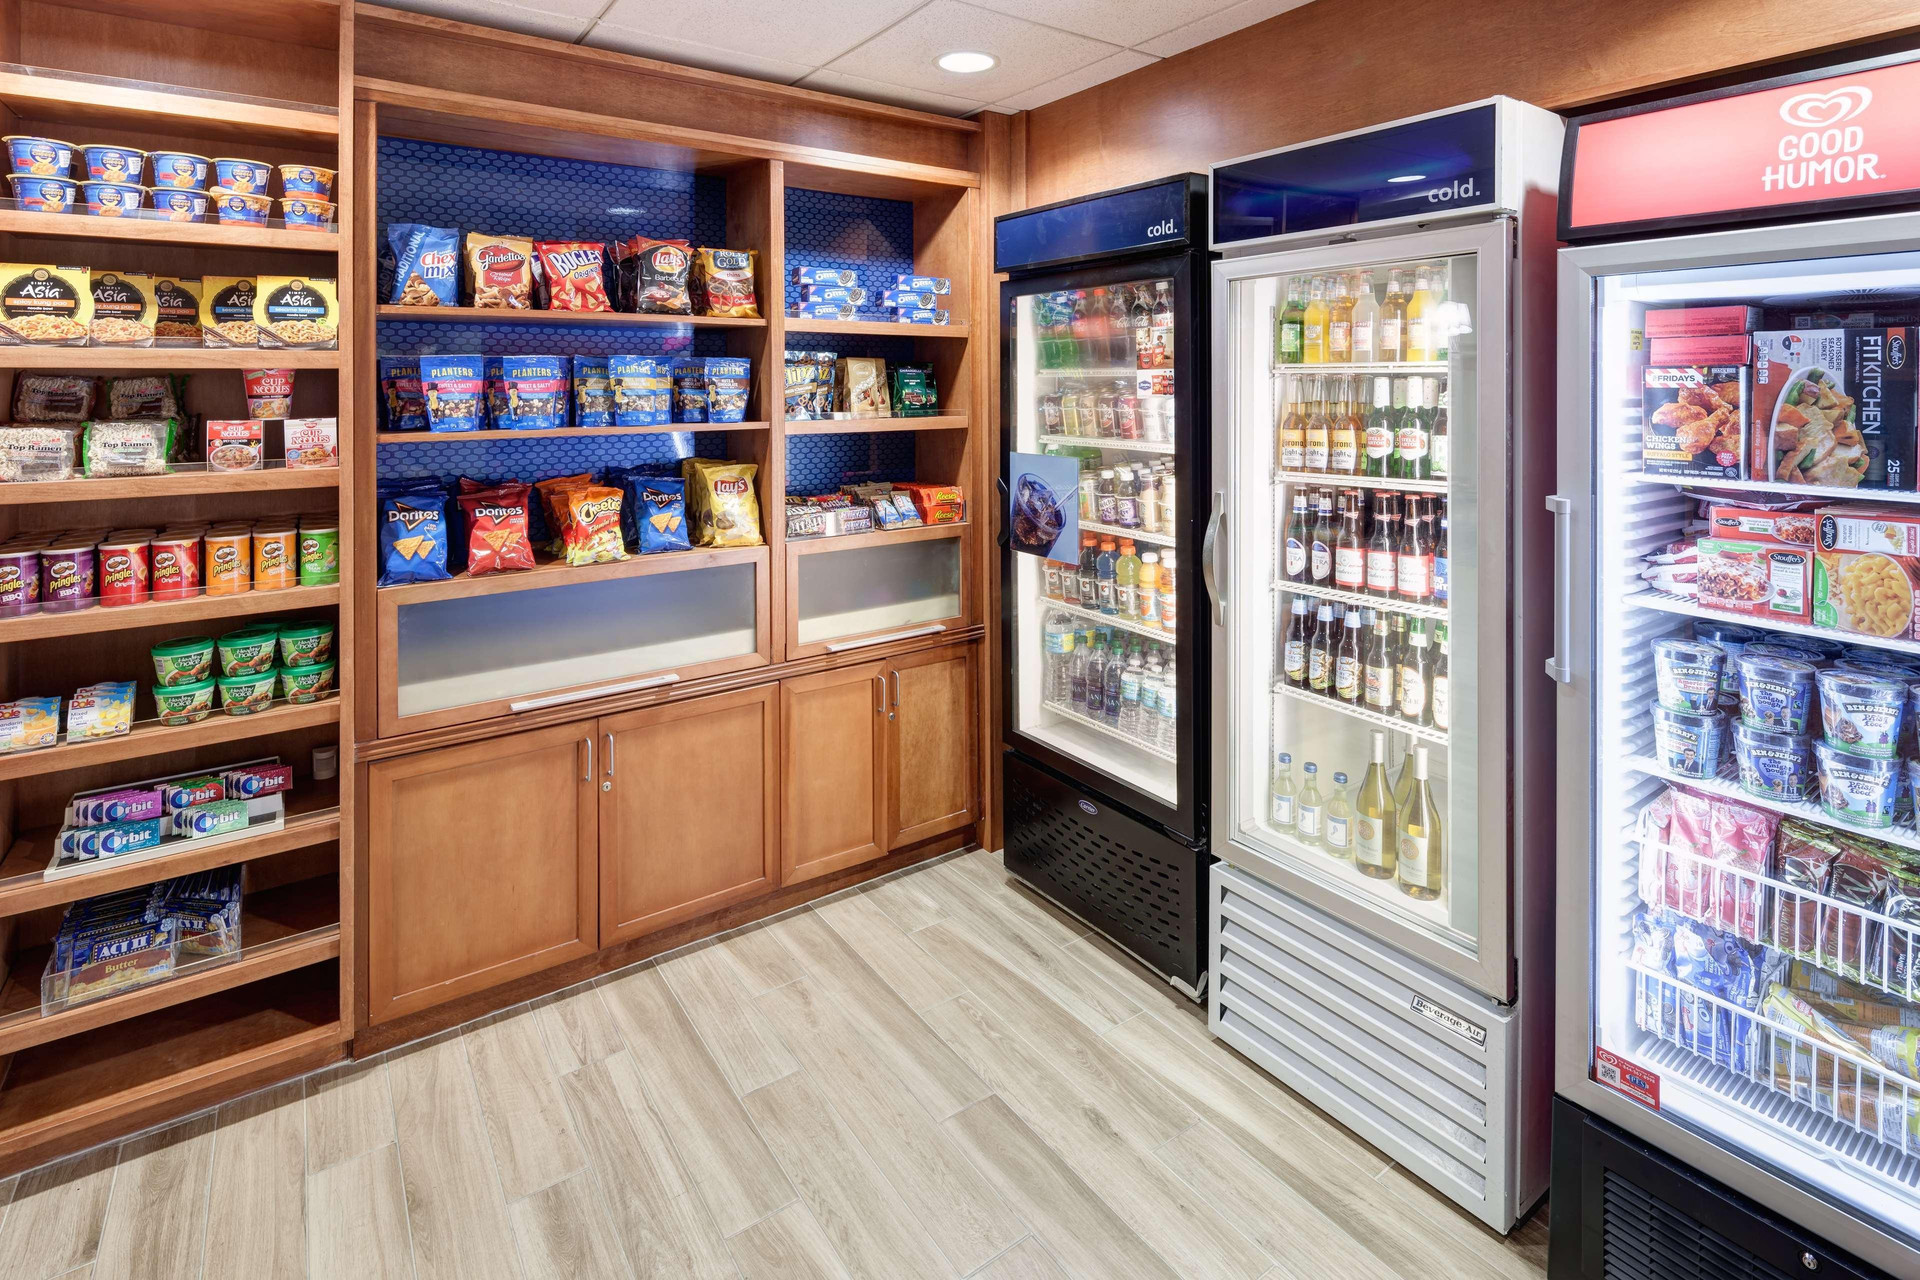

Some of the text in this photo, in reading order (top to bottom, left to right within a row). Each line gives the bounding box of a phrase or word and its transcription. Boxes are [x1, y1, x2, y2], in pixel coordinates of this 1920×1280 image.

[1778, 126, 1863, 162] GOOD
[1428, 178, 1481, 203] cold.
[1147, 219, 1178, 237] cold.
[391, 230, 425, 287] TRADITIONAL
[421, 251, 456, 266] Chex
[655, 252, 683, 266] Lay's
[717, 258, 746, 268] GOLD
[424, 264, 455, 279] mix
[655, 274, 685, 282] Barbecue
[20, 284, 60, 299] Asia
[280, 294, 312, 307] Asia
[1892, 339, 1902, 365] Stouffer's
[431, 367, 473, 378] PLANTERS
[512, 368, 552, 378] PLANTERS
[617, 366, 651, 375] PLANTERS
[712, 368, 744, 376] PLANTERS
[262, 378, 285, 386] CUP
[1862, 335, 1882, 434] FITKITCHEN
[253, 385, 290, 394] NOODLES
[291, 435, 330, 445] NOODLES
[300, 429, 323, 437] CUP
[1887, 459, 1900, 473] 25
[716, 480, 746, 494] Lay's
[643, 492, 682, 502] Doritos
[388, 510, 439, 522] Doritos
[475, 507, 523, 517] Doritos
[580, 497, 621, 523] Cheetos
[1718, 518, 1739, 526] Stouffer's
[1824, 519, 1835, 547] Stouffer's
[261, 555, 288, 571] Pringles
[1773, 554, 1802, 563] Stouffer's
[154, 565, 180, 581] Pringles
[213, 559, 241, 576] Pringles
[50, 575, 81, 593] Pringles
[105, 569, 134, 586] Pringles
[2, 592, 23, 602] BBQ
[60, 587, 80, 597] BBQ
[72, 699, 95, 708] Dole
[1755, 695, 1784, 705] Tonight
[1757, 700, 1781, 708] Dough
[1873, 705, 1899, 716] JERRY'S
[1762, 762, 1792, 772] Tonight
[1832, 770, 1851, 778] BEN
[241, 775, 285, 796] Orbit
[170, 787, 217, 809] Orbit
[104, 799, 154, 823] Orbit
[193, 810, 241, 833] Orbit
[101, 828, 152, 854] Orbit
[1780, 905, 1791, 942] ALMOND
[99, 935, 148, 958] ACT II
[105, 957, 139, 974] Butter
